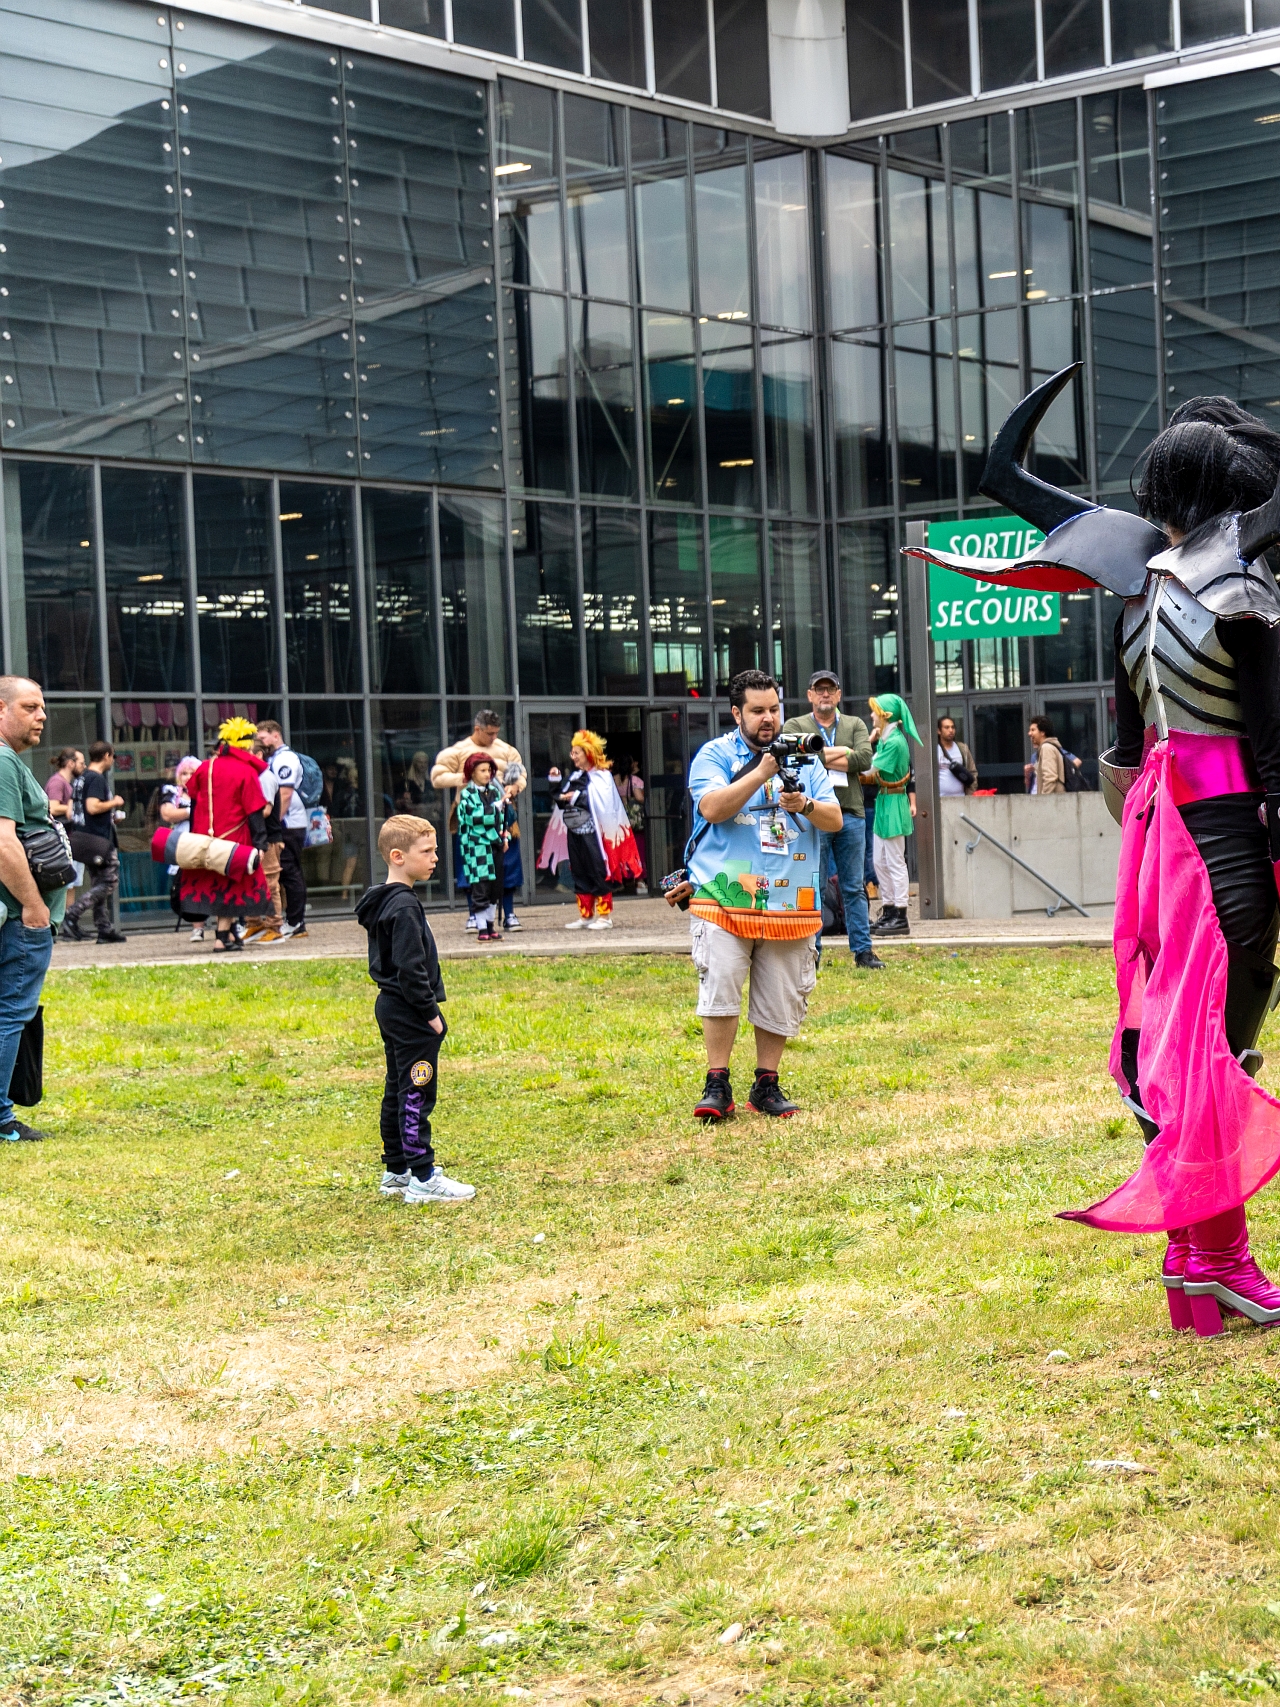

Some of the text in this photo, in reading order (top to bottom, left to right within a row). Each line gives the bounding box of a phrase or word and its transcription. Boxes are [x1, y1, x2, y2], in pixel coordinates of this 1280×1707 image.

[949, 529, 1038, 558] SORTIE
[935, 594, 1054, 628] SECOURS
[402, 1087, 427, 1156] LAKERS
